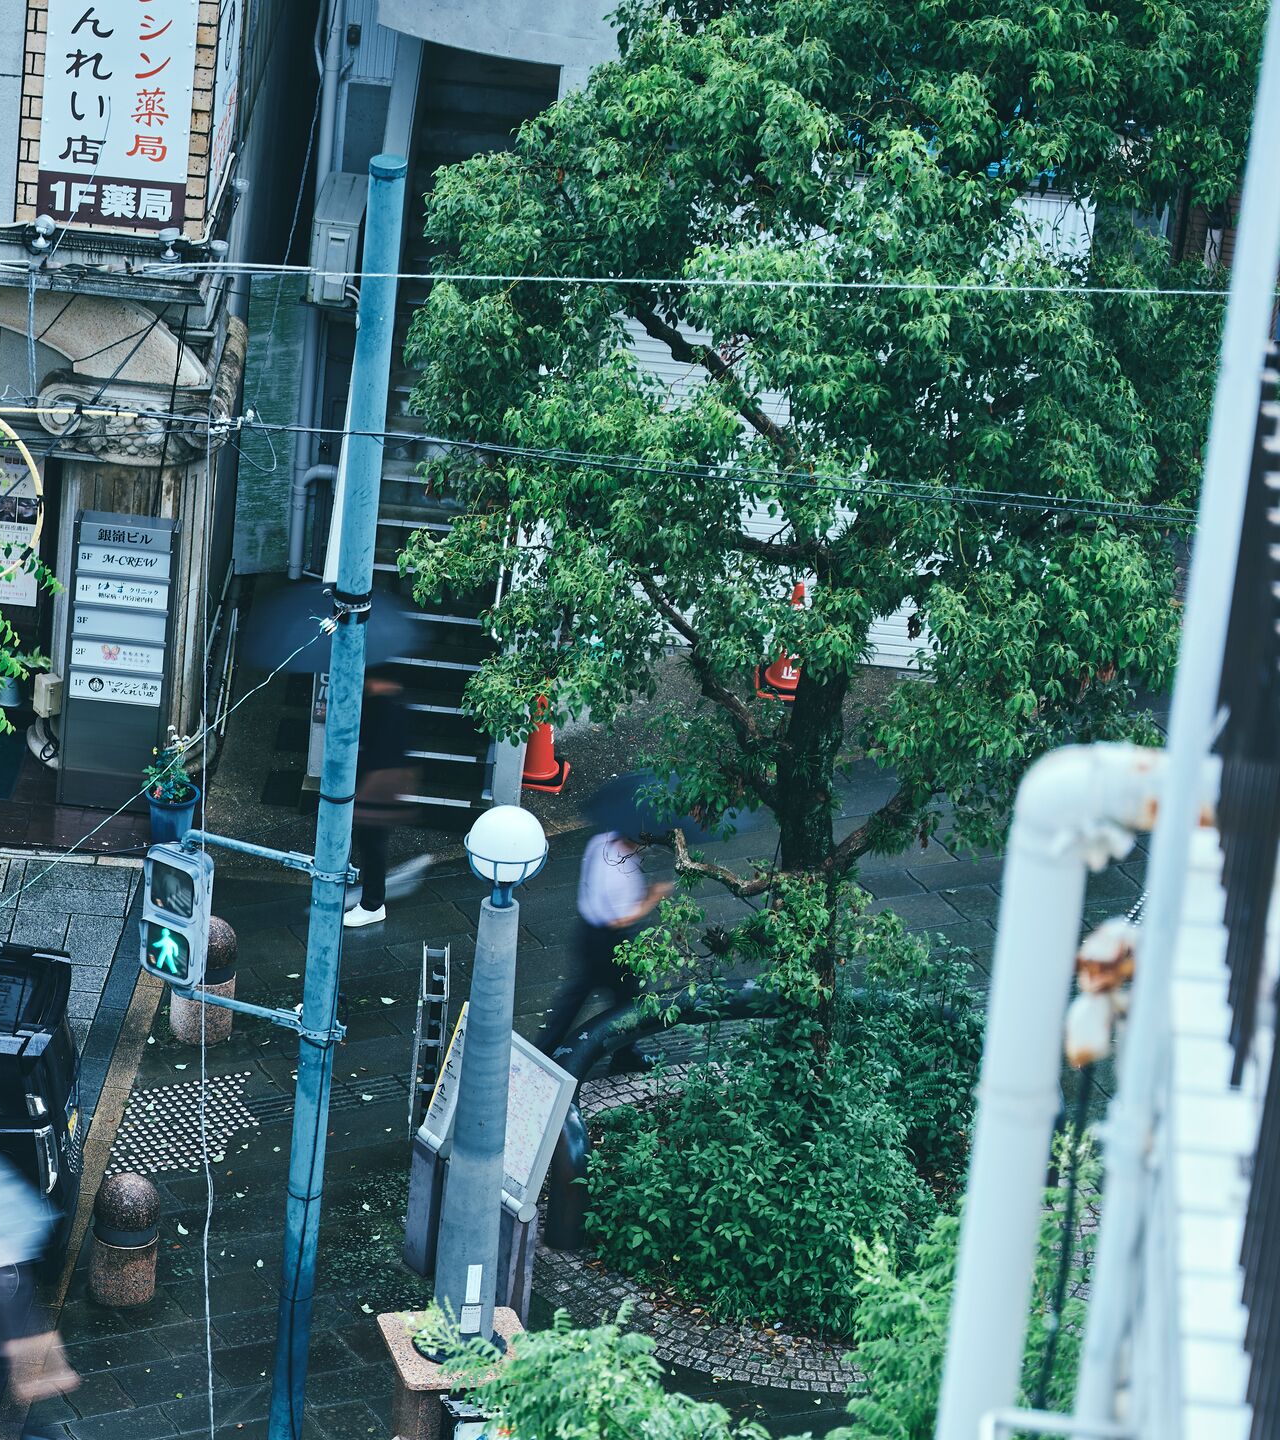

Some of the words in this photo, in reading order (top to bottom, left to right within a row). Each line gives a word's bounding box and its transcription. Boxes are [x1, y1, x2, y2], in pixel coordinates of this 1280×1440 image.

[126, 0, 173, 162] シン薬局
[97, 528, 153, 546] 銀嶺ビル
[81, 552, 93, 561] 5F
[102, 554, 158, 569] M-CREW
[76, 616, 89, 625] 3F
[75, 647, 87, 656] 2F
[74, 679, 85, 687] 1F
